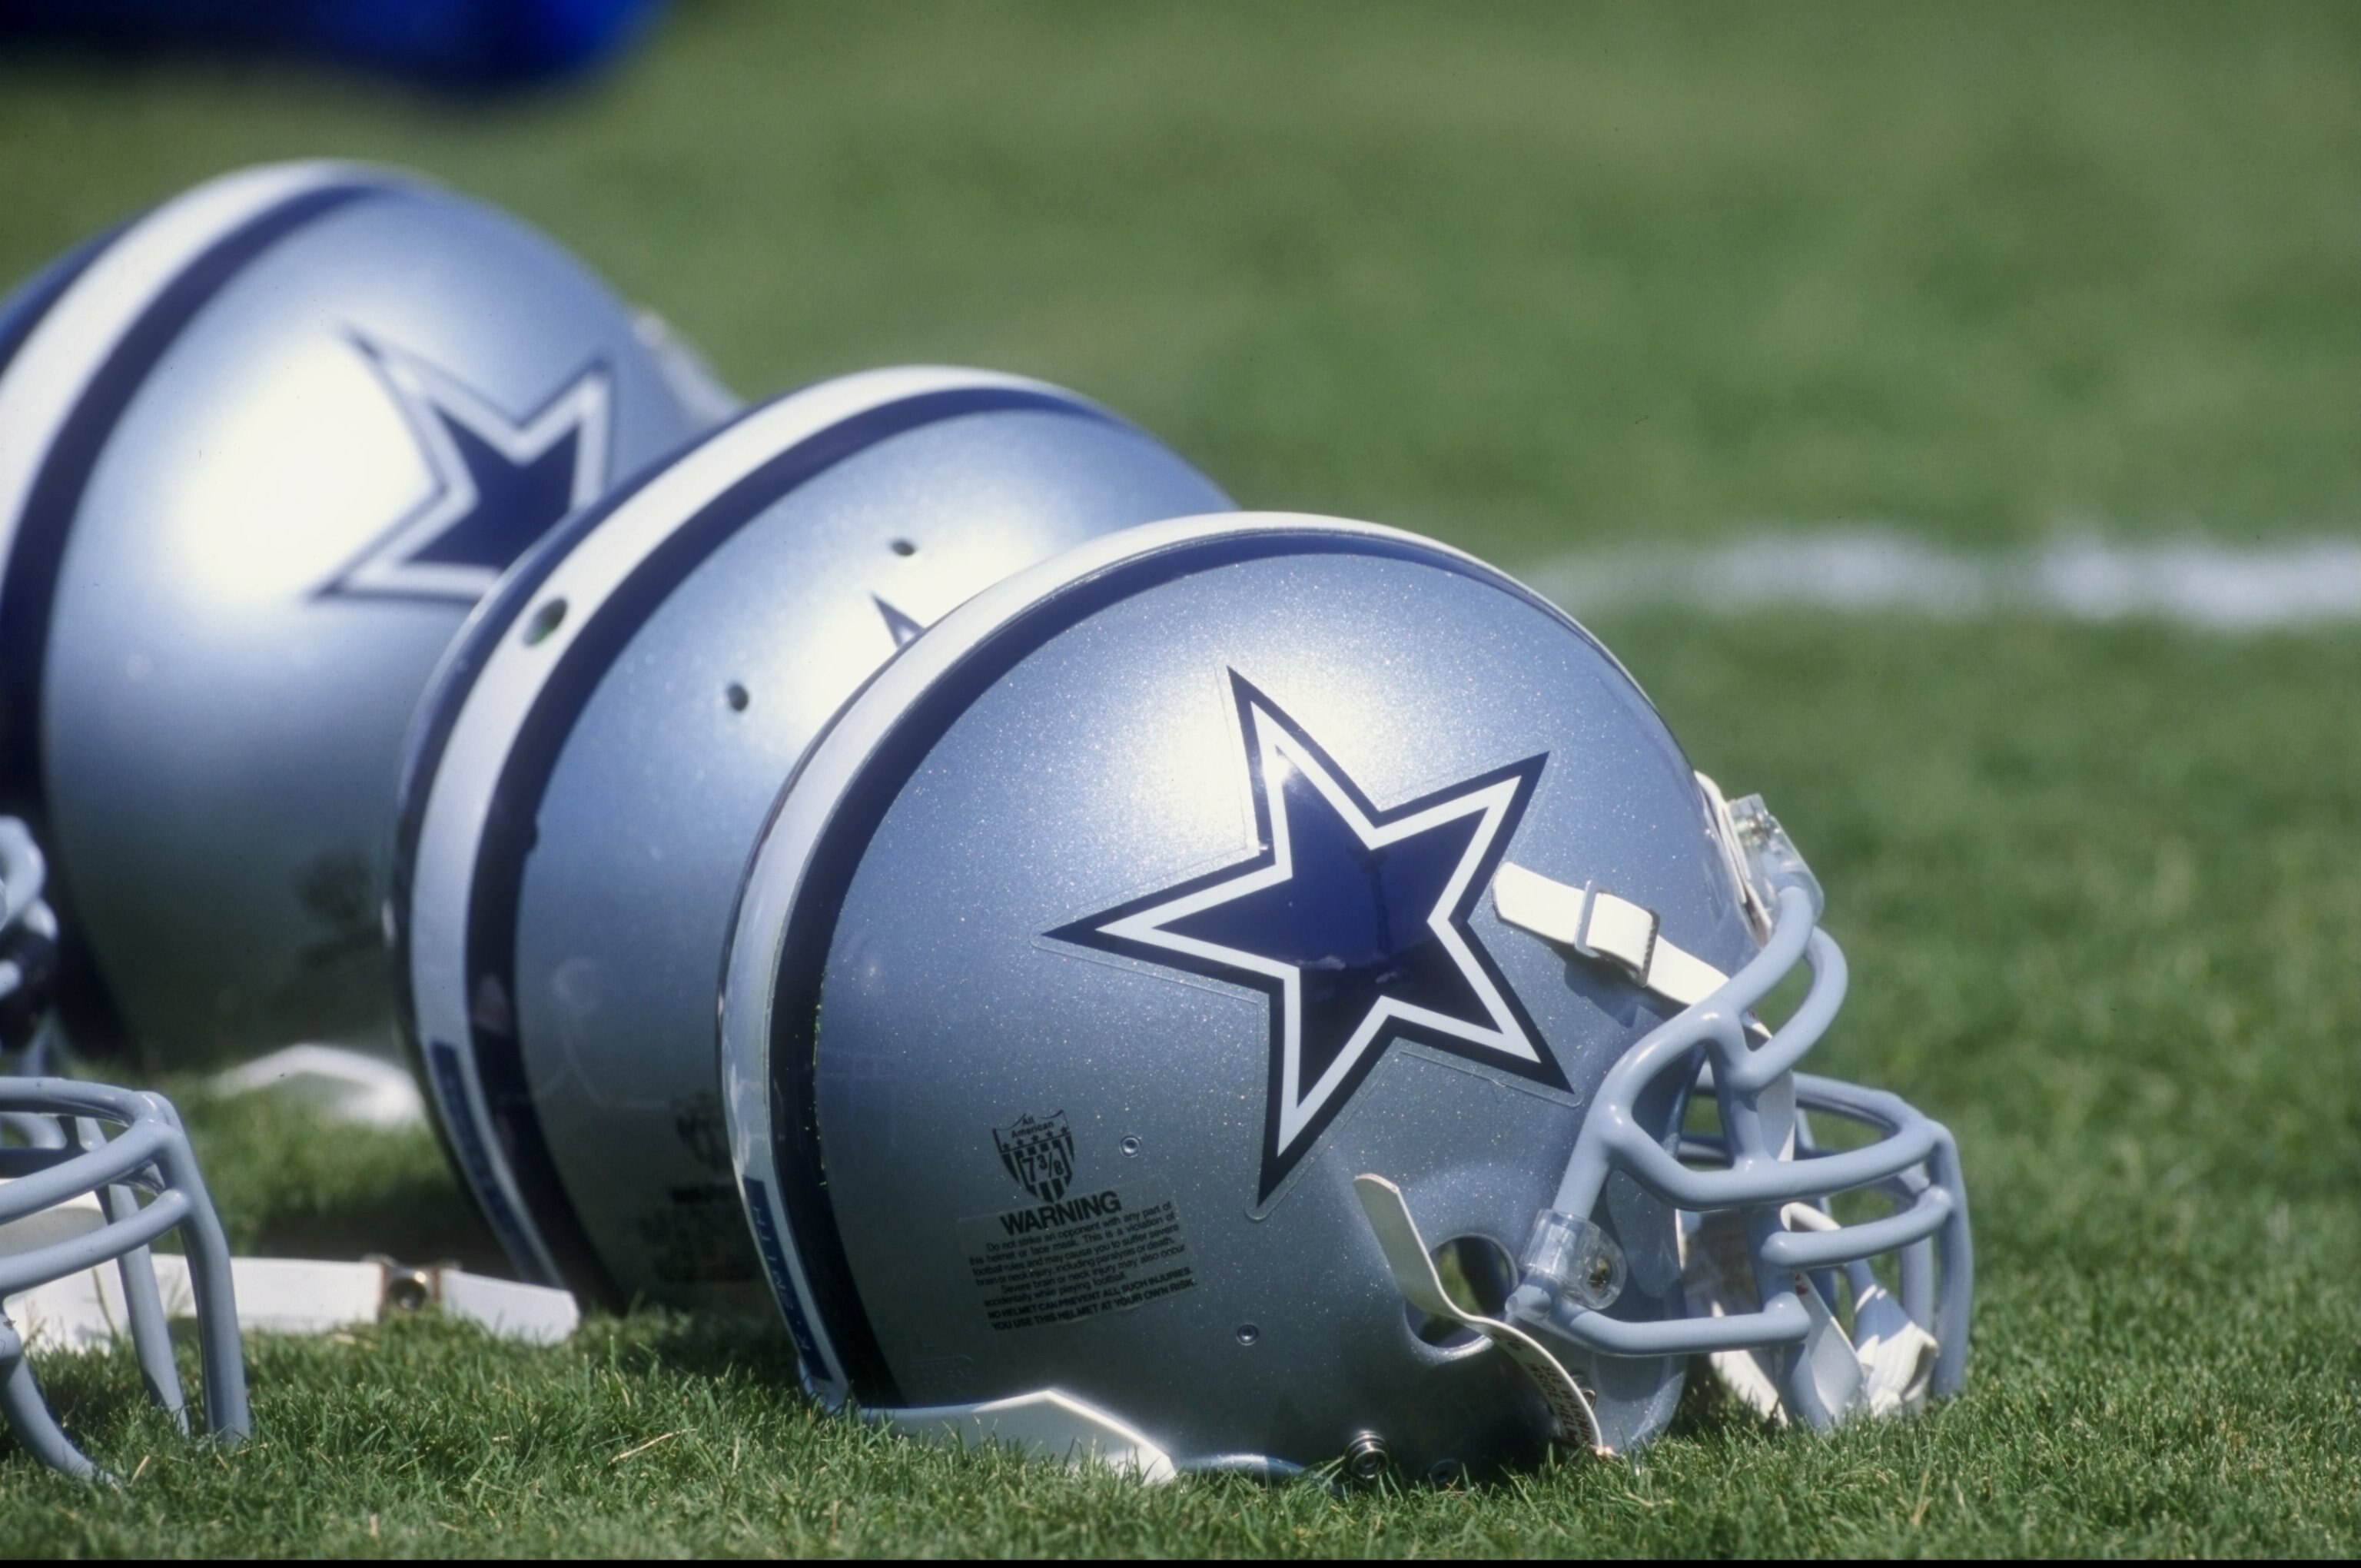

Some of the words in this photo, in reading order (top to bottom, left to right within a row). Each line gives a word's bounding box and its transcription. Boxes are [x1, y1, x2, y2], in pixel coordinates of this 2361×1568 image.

[1011, 1121, 1054, 1138] American
[1021, 1116, 1034, 1125] All
[985, 1242, 1000, 1252] Do
[1001, 1239, 1015, 1249] not
[1018, 1235, 1041, 1247] strike
[1044, 1233, 1055, 1241] an
[1058, 1221, 1100, 1238] opponent
[1101, 1216, 1121, 1227] with
[1123, 1211, 1140, 1223] any
[1142, 1204, 1160, 1218] part
[1161, 1200, 1172, 1211] of
[1000, 1191, 1121, 1234] WARNING
[968, 1256, 984, 1265] this
[985, 1251, 1016, 1262] helmet
[1018, 1249, 1027, 1257] or
[1029, 1244, 1050, 1255] face
[1081, 1232, 1103, 1243] This
[1104, 1229, 1114, 1238] is
[1125, 1216, 1164, 1232] violation
[1165, 1211, 1175, 1221] of
[971, 1264, 1003, 1276] football
[1003, 1261, 1024, 1271] rules
[1026, 1256, 1043, 1267] and
[1044, 1254, 1063, 1264] may
[1064, 1247, 1092, 1260] cause
[1093, 1243, 1110, 1255] you
[1111, 1240, 1121, 1248] to
[1121, 1232, 1147, 1246] suffer
[1148, 1224, 1179, 1237] severe
[975, 1277, 998, 1287] brain
[998, 1275, 1006, 1284] or
[1008, 1271, 1028, 1281] neck
[1095, 1247, 1136, 1265] paralysis
[1136, 1244, 1145, 1253] or
[1001, 1282, 1031, 1294] Severe
[1031, 1277, 1055, 1288] brain
[1056, 1275, 1065, 1284] or
[1068, 1269, 1090, 1281] neck
[1091, 1264, 1116, 1276] injury
[1117, 1258, 1137, 1269] may
[1140, 1252, 1158, 1264] also
[1160, 1244, 1185, 1257] occur
[987, 1310, 1001, 1319] NO
[1001, 1304, 1036, 1317] HELMET
[1038, 1301, 1058, 1311] CAN
[1058, 1291, 1100, 1307] PREVENT
[1102, 1287, 1121, 1297] ALL
[1121, 1279, 1147, 1292] SUCH
[991, 1320, 1012, 1330] YOU
[1012, 1316, 1033, 1328] USE
[1033, 1312, 1056, 1324] THIS
[1057, 1303, 1097, 1320] HELMET
[1101, 1300, 1111, 1311] AT
[1113, 1292, 1142, 1307] YOUR
[1144, 1286, 1168, 1299] OWN
[1034, 1287, 1056, 1298] while
[1058, 1281, 1091, 1296] playing
[1561, 1390, 1595, 1445] WARNIN
